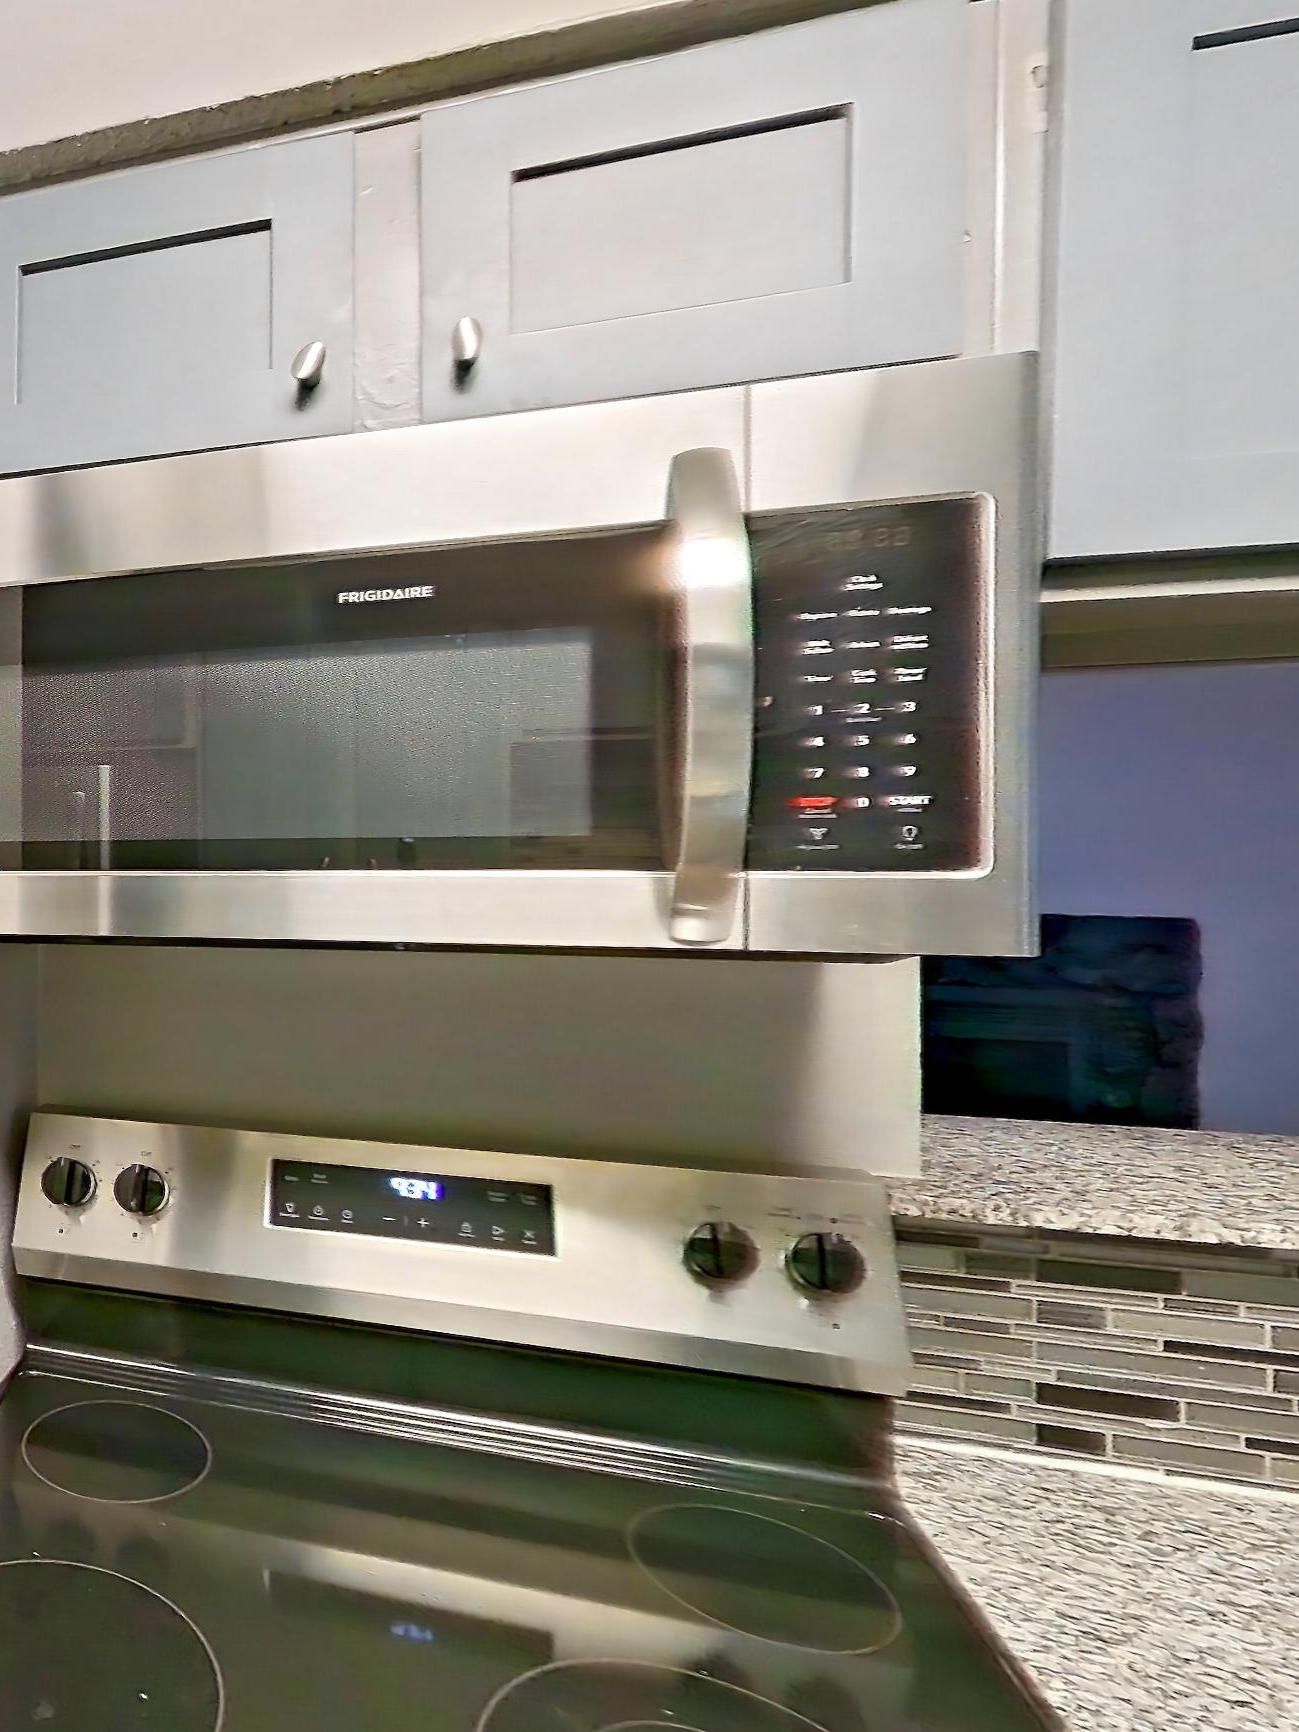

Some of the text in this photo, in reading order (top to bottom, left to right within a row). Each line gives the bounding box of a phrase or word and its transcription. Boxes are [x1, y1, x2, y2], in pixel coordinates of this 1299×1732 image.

[338, 585, 435, 603] FRIGIDAIRE
[853, 702, 871, 714] 2
[901, 701, 918, 712] 3
[810, 736, 825, 747] 4
[854, 734, 870, 747] 5
[901, 733, 917, 745] 6
[807, 767, 825, 779] 7
[854, 766, 870, 778] 8
[901, 765, 917, 777] 9
[855, 796, 870, 808] 0
